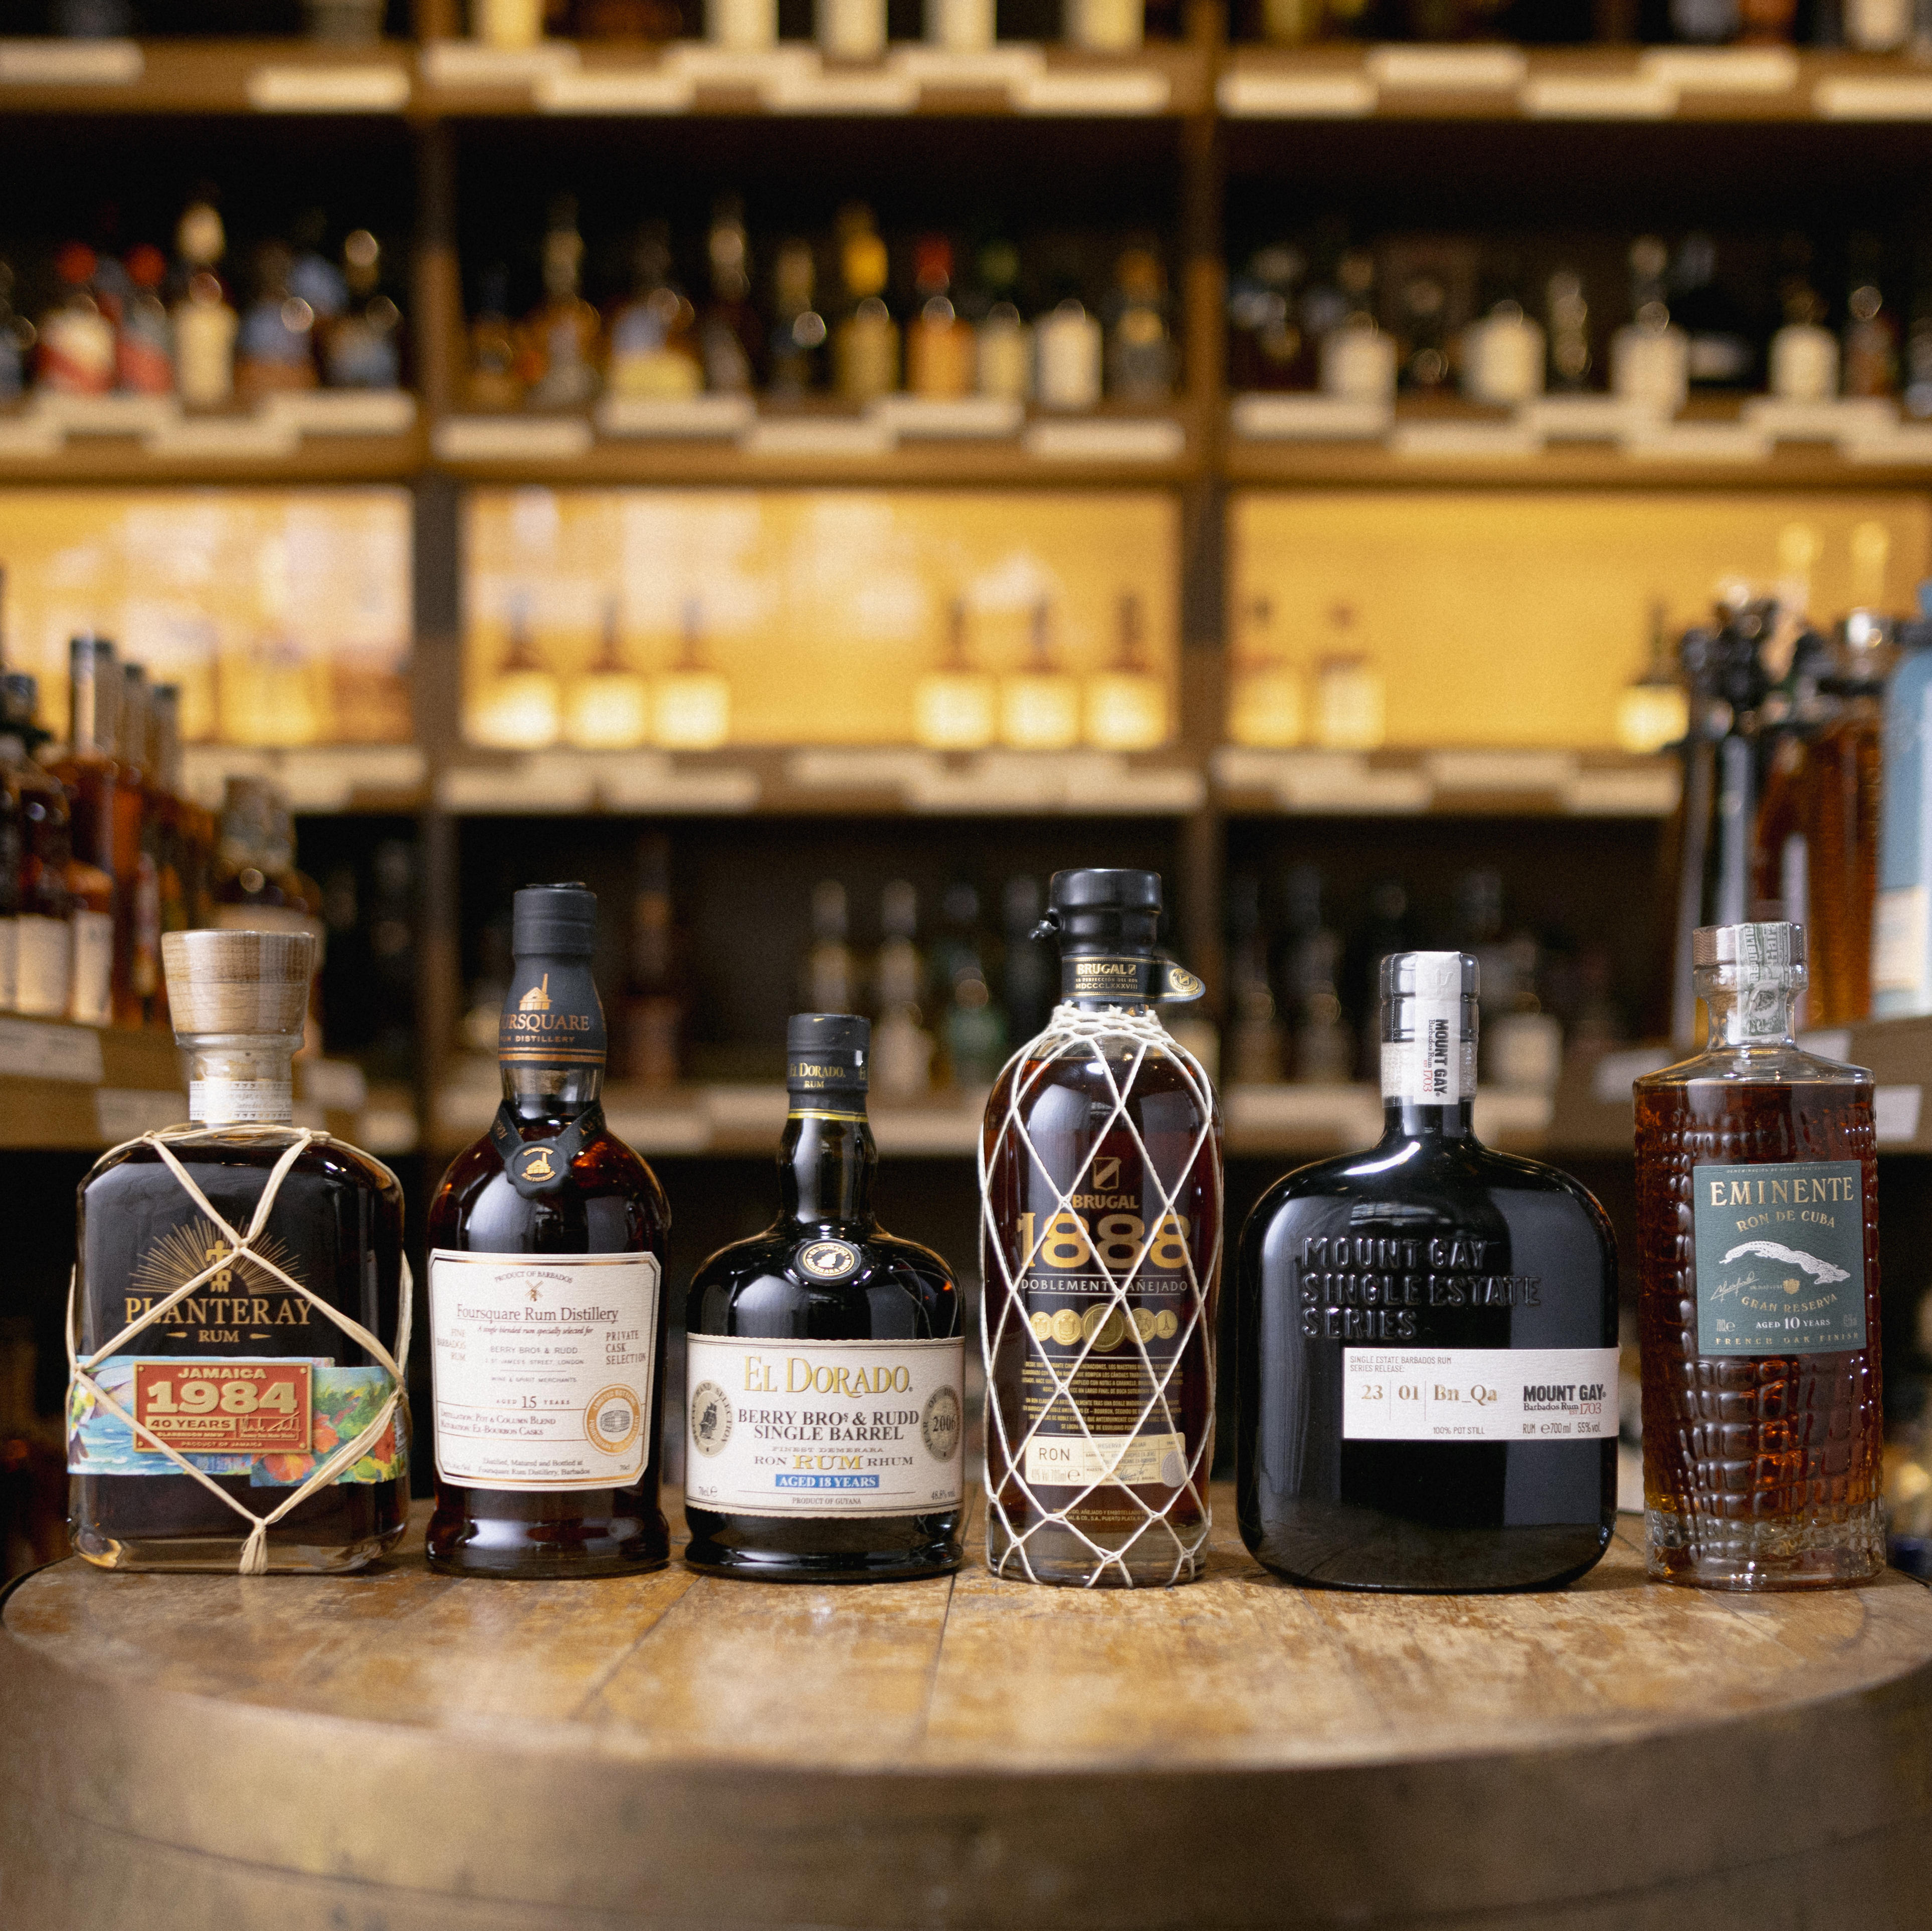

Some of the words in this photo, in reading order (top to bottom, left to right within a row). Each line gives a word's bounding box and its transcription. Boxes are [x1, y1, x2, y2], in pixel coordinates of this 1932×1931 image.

[1076, 963, 1127, 975] BRUGAL
[1434, 1019, 1449, 1066] MOUNT
[799, 1062, 844, 1078] DORADO
[804, 1080, 825, 1089] RUM
[1423, 1069, 1433, 1092] 1703
[1434, 1068, 1448, 1095] GAY
[1710, 1177, 1854, 1207] EMINENTE
[1072, 1195, 1140, 1209] BRUGAL
[1736, 1213, 1769, 1233] RON
[1776, 1210, 1796, 1222] DE
[1801, 1210, 1835, 1228] CUBA
[1017, 1212, 1192, 1269] 1888
[1303, 1237, 1420, 1269] MOUNT
[1429, 1237, 1488, 1269] GAY
[494, 1271, 524, 1282] PRODUCT
[537, 1271, 573, 1283] BARBADOS
[1302, 1272, 1421, 1305] SINGLE
[1429, 1274, 1541, 1307] ESTATE
[1741, 1296, 1778, 1312] GRAN
[1784, 1293, 1837, 1313] RESERVA
[125, 1298, 314, 1325] PLANTERAY
[457, 1304, 521, 1324] Foursquare
[524, 1307, 556, 1321] Rum
[561, 1307, 619, 1324] Distillery
[1302, 1307, 1417, 1340] SERIES
[1784, 1317, 1801, 1329] 10
[1803, 1319, 1830, 1327] YEARS
[198, 1330, 240, 1343] RUM
[584, 1326, 594, 1336] for
[606, 1330, 639, 1342] PRIVATE
[1715, 1337, 1773, 1345] FRENCH
[1783, 1336, 1810, 1344] OAK
[1819, 1332, 1859, 1342] FINISH
[606, 1343, 627, 1353] CASK
[606, 1353, 647, 1365] SELECTION
[178, 1368, 267, 1379] JAMAICA
[786, 1357, 910, 1398] DORADO
[147, 1380, 298, 1414] 1984
[1361, 1384, 1384, 1400] 23
[1398, 1384, 1420, 1400] 01
[1523, 1385, 1576, 1402] MOUNT
[1579, 1383, 1604, 1401] GAY
[522, 1396, 537, 1408] 15
[1523, 1402, 1560, 1411] Barbados
[1561, 1402, 1579, 1410] Rum
[1580, 1402, 1602, 1415] 1703
[151, 1419, 171, 1428] 40
[177, 1419, 231, 1428] YEARS
[738, 1409, 797, 1424] BERRY
[852, 1412, 867, 1425] &
[873, 1410, 919, 1425] RUDD
[933, 1414, 958, 1432] 2006
[754, 1426, 823, 1440] SINGLE
[830, 1426, 904, 1441] BARREL
[1467, 1427, 1485, 1435] STILL
[1522, 1423, 1535, 1434] RUM
[1578, 1422, 1591, 1433] 55%
[1039, 1447, 1070, 1461] RON
[754, 1456, 787, 1465] RON
[793, 1454, 864, 1470] RUM
[867, 1456, 914, 1466] RHUM
[779, 1476, 816, 1487] AGED
[818, 1477, 832, 1487] 18
[835, 1477, 876, 1487] YEARS
